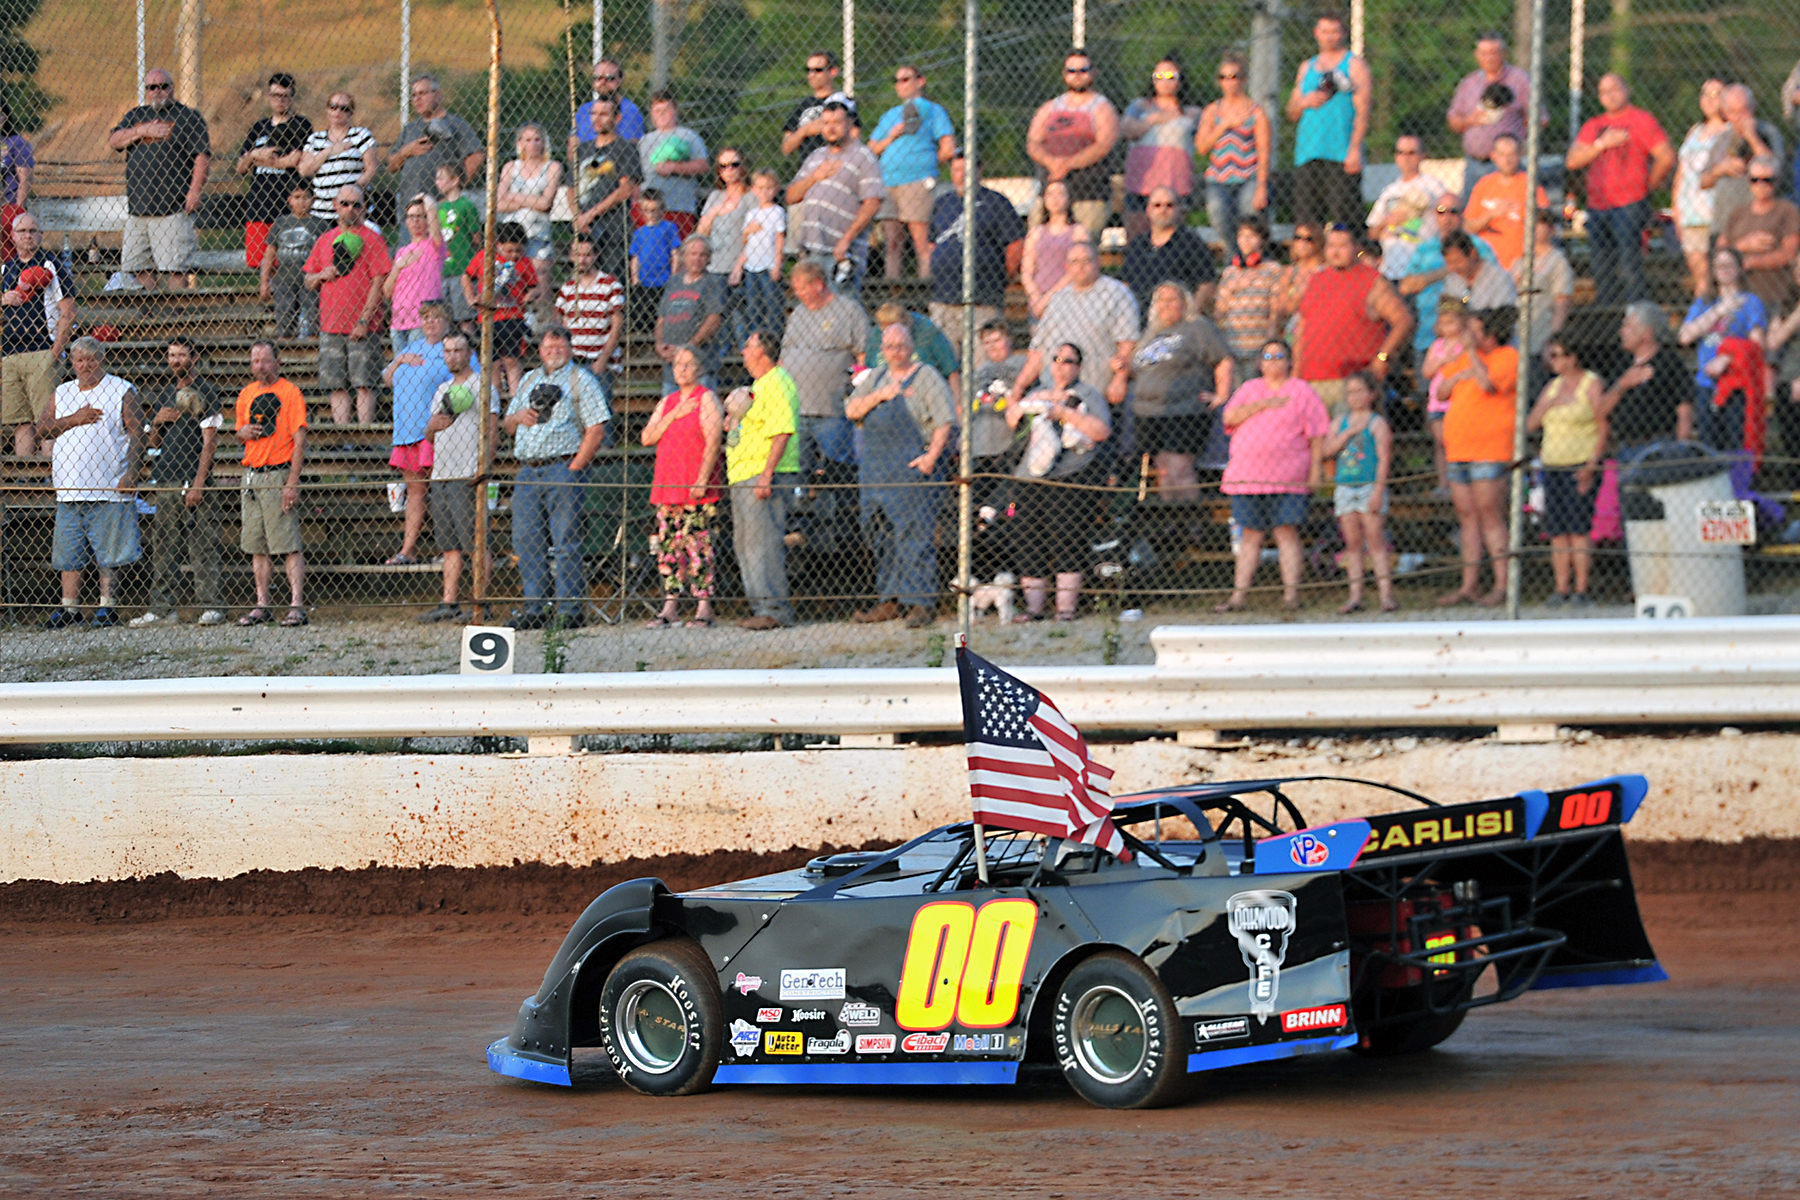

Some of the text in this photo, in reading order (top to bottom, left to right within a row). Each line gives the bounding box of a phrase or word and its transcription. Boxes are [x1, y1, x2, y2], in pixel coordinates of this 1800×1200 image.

[469, 632, 509, 671] 9
[1559, 790, 1613, 829] 00
[1292, 836, 1316, 865] VP
[1234, 906, 1289, 930] OAKWOOD
[895, 897, 1039, 1032] 00
[1255, 933, 1272, 998] CAFE
[782, 971, 843, 989] GenTech
[667, 974, 700, 1050] Hoosier
[759, 1009, 780, 1018] MSD
[791, 1008, 826, 1022] Hoosier
[850, 1009, 879, 1019] WELD
[1286, 1008, 1341, 1028] BRINN
[600, 1005, 633, 1079] Hoosier
[777, 1034, 796, 1042] Auto
[903, 1033, 948, 1049] Eibach
[954, 1034, 1003, 1050] Mobil 1
[1055, 992, 1078, 1072] Hoosier
[1139, 997, 1161, 1078] Hoosier
[775, 1042, 800, 1051] Meter
[808, 1038, 844, 1049] Fragola
[860, 1038, 892, 1049] SIMPSON
